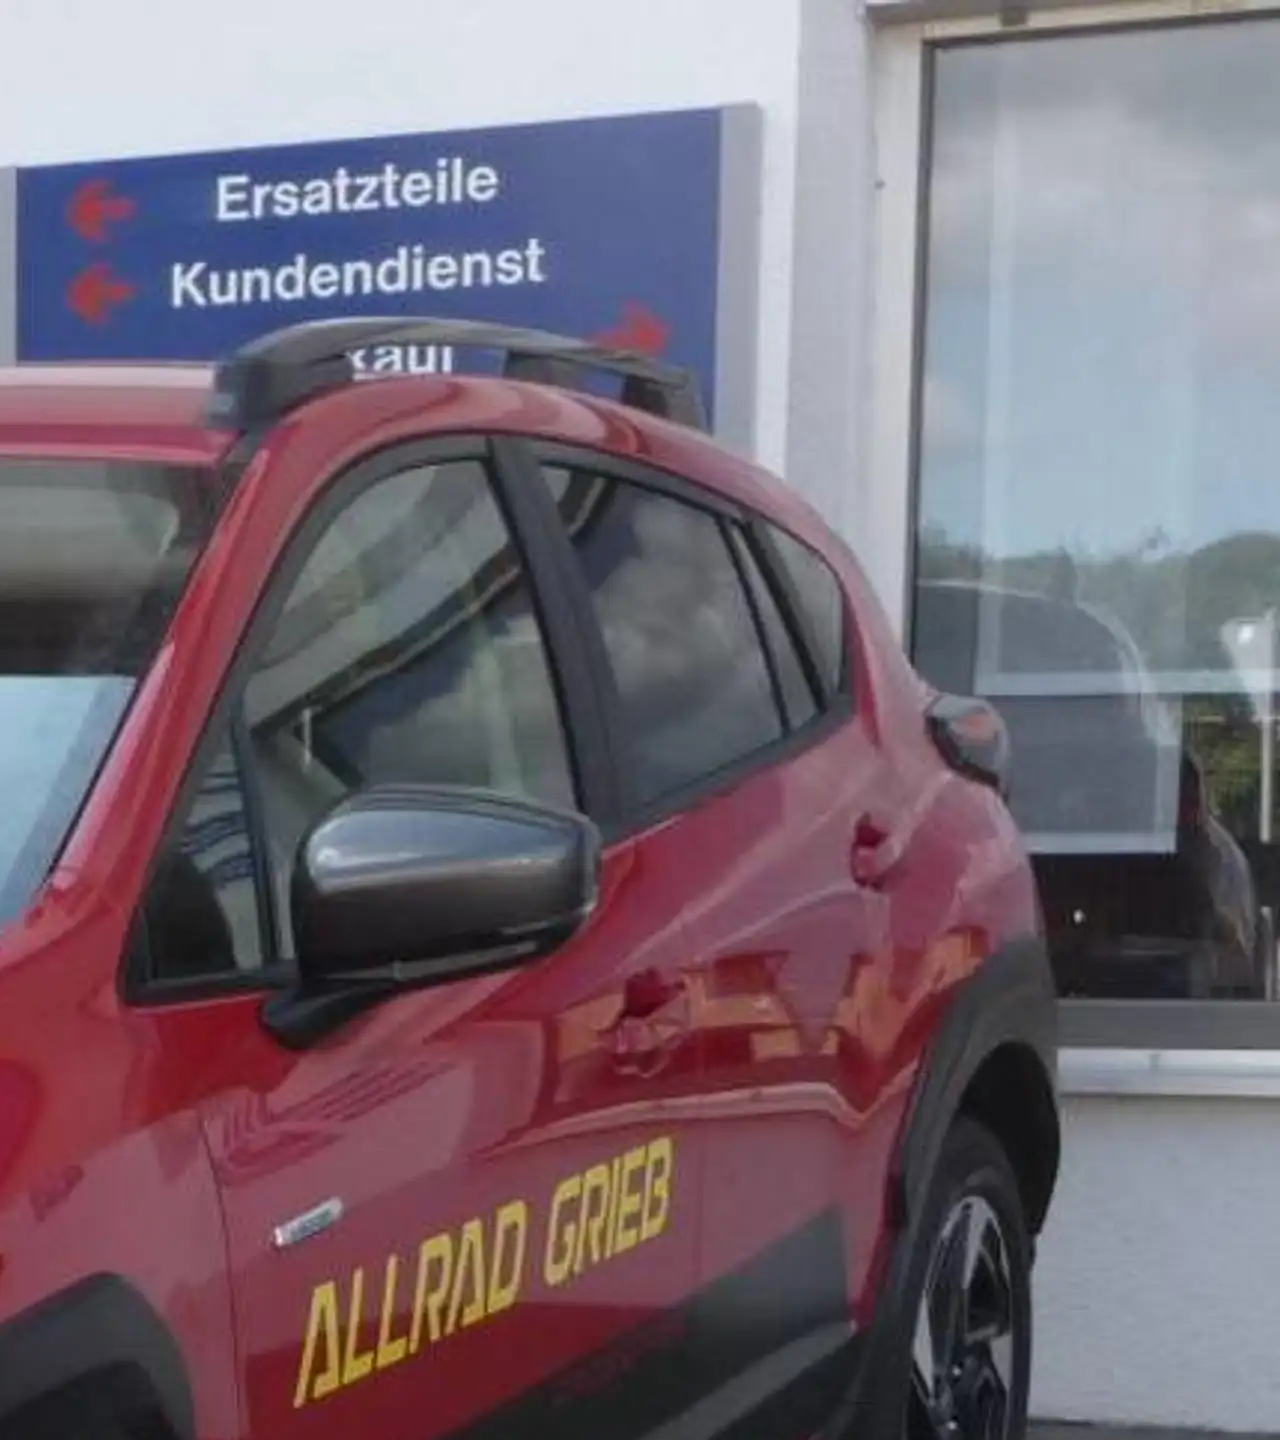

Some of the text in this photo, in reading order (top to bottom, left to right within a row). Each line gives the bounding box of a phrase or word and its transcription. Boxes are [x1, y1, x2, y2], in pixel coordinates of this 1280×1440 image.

[216, 157, 499, 221] Ersatzteile
[171, 238, 547, 308] Kundendienst
[293, 1201, 528, 1408] ALLRAD
[545, 1136, 673, 1286] GRIEB
